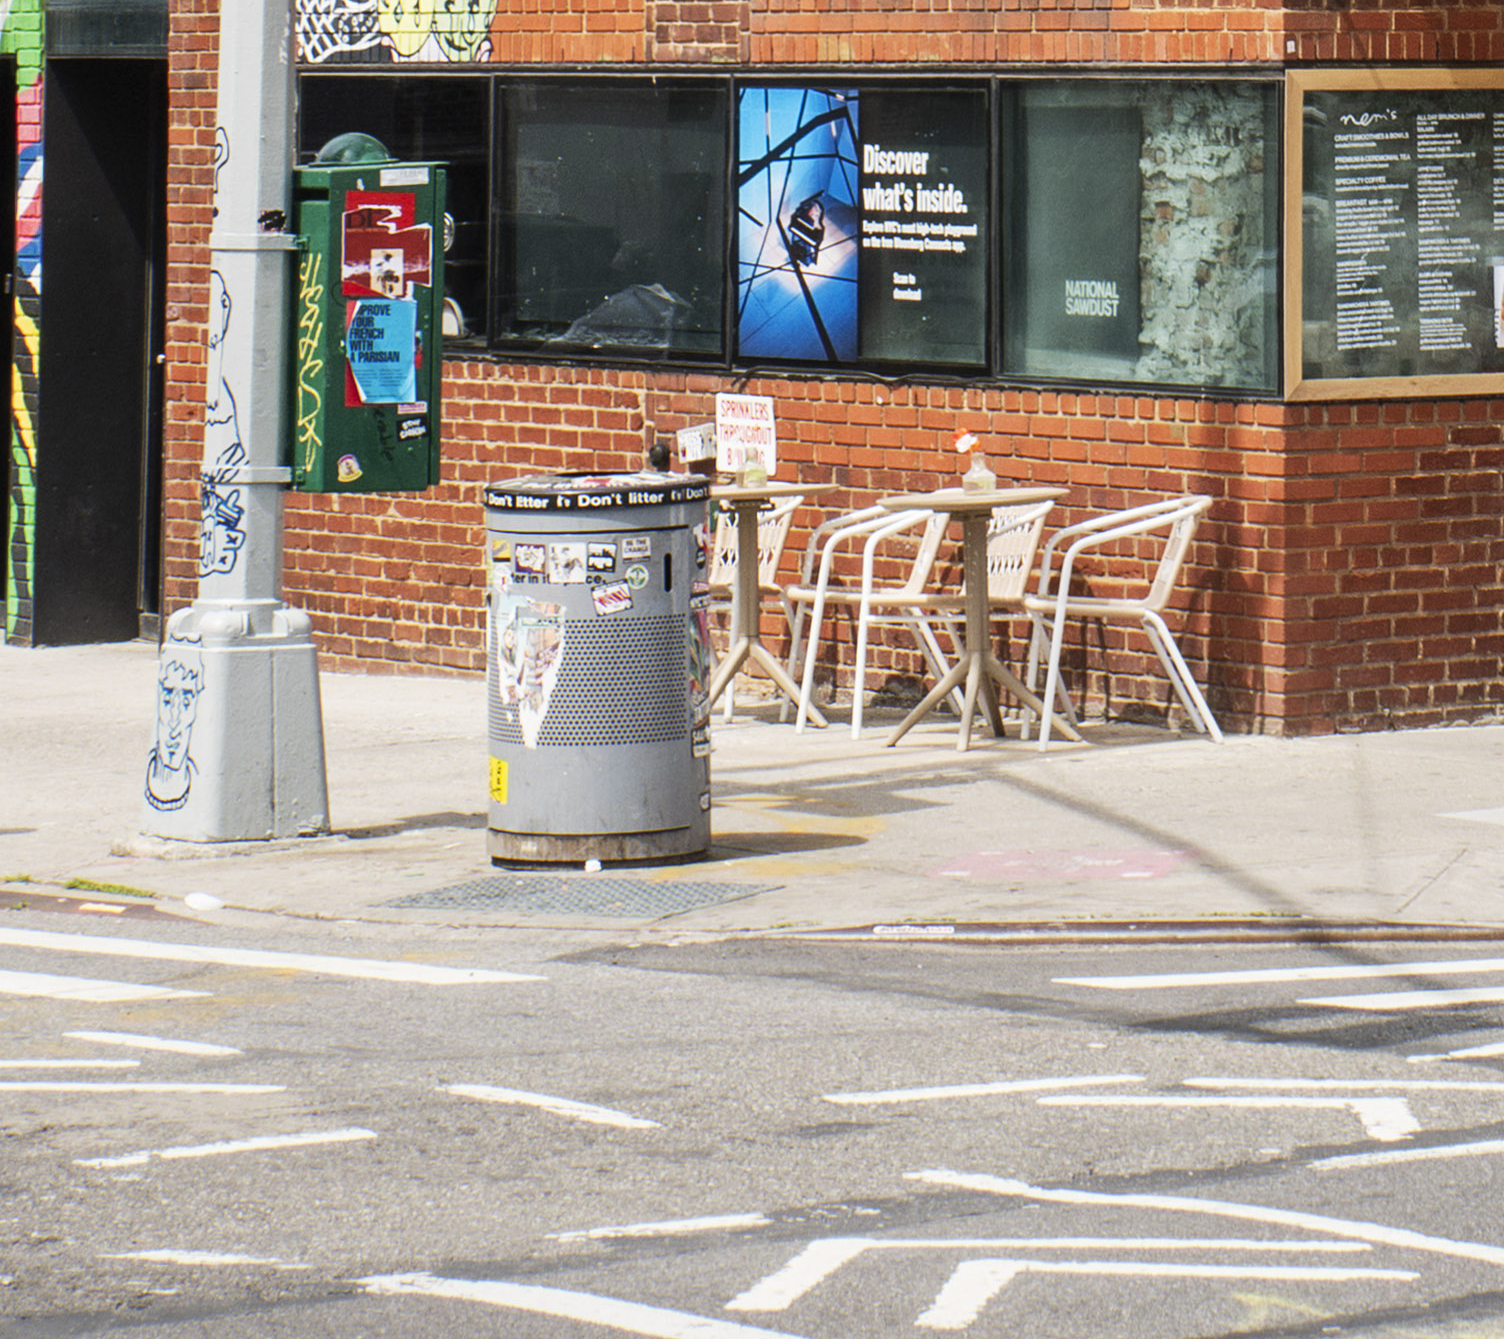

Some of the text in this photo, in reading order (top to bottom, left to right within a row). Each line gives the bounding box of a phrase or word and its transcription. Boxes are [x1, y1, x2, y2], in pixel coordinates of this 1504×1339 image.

[1340, 108, 1397, 126] nem's
[863, 144, 929, 175] Discover
[863, 182, 968, 213] what's inside.
[1065, 280, 1120, 298] NATIONAL
[357, 304, 391, 316] PROVE
[1065, 297, 1119, 317] SAWDUST
[350, 328, 384, 340] FRENCH
[350, 339, 373, 351] WITH
[351, 351, 400, 363] A PARISIAN
[721, 399, 769, 420] SPRINKLERS
[488, 492, 513, 508] Don't
[577, 492, 664, 507] Don't litter
[528, 573, 539, 584] in
[542, 573, 550, 584] it
